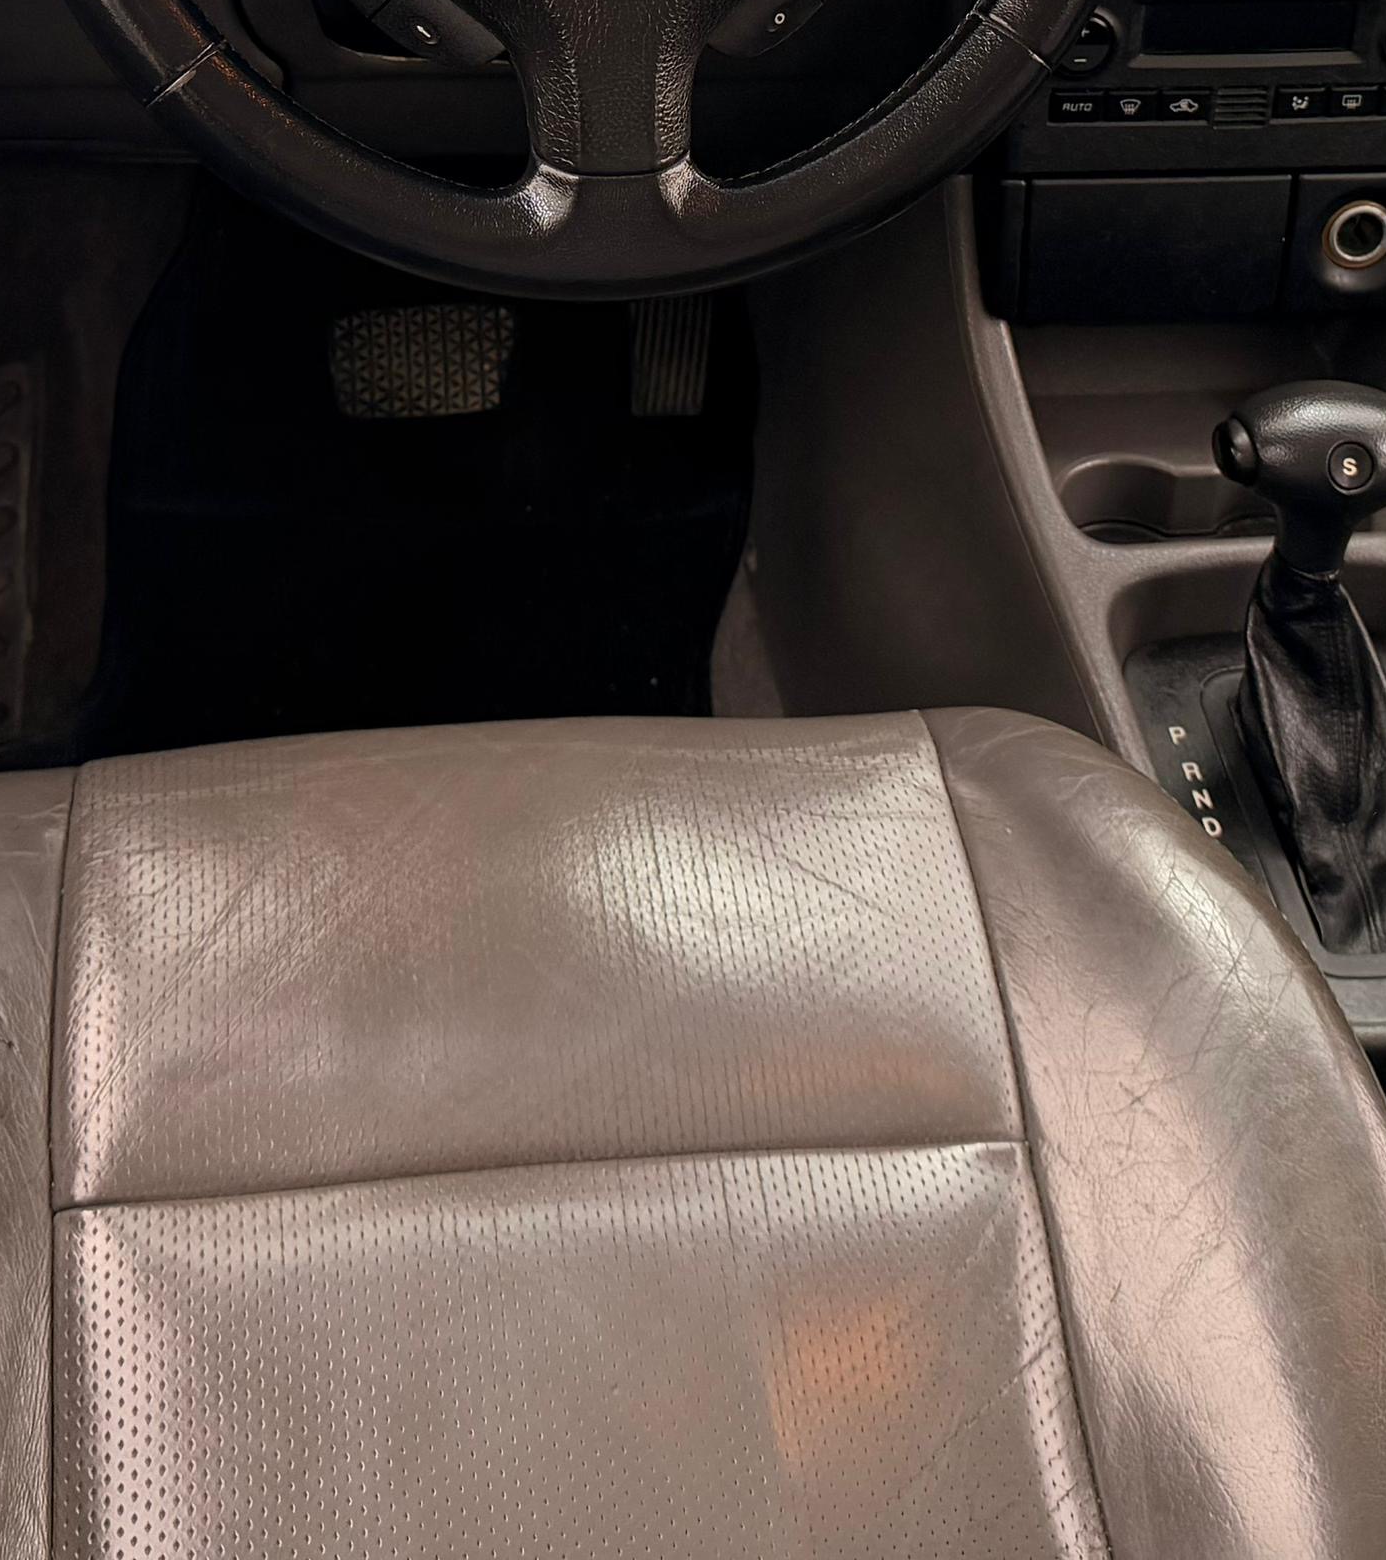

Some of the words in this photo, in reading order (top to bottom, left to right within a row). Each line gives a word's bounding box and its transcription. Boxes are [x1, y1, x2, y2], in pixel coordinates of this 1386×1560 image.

[1062, 103, 1093, 112] AUTO
[1342, 457, 1358, 476] S
[1168, 726, 1187, 745] P
[1182, 762, 1203, 781] R
[1192, 789, 1213, 810] N
[1201, 816, 1222, 837] D
